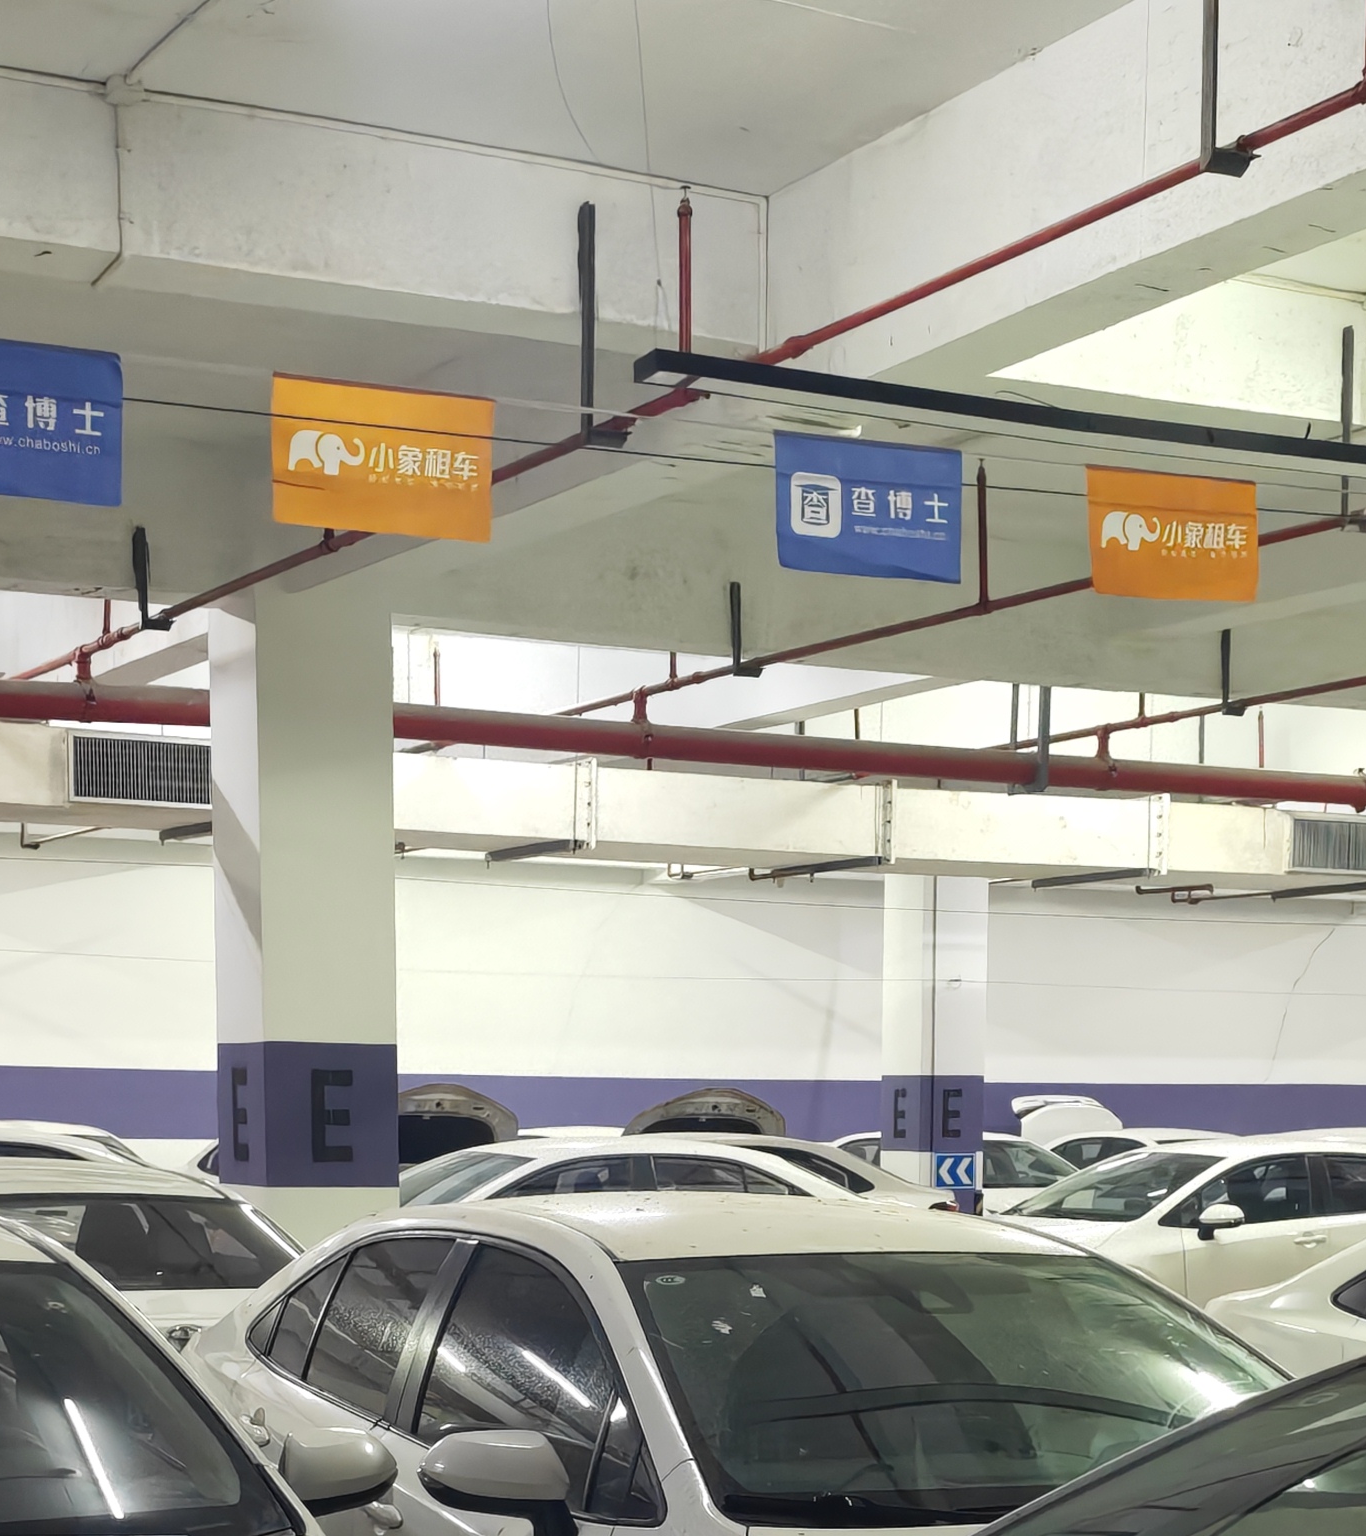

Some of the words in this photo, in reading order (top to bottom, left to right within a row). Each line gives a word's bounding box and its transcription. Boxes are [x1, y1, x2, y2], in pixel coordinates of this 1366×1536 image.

[368, 442, 480, 481] 小象租车
[851, 486, 950, 524] 查博士
[1161, 520, 1248, 550] 小象租车
[311, 1069, 353, 1163] E
[942, 1089, 962, 1138] E
